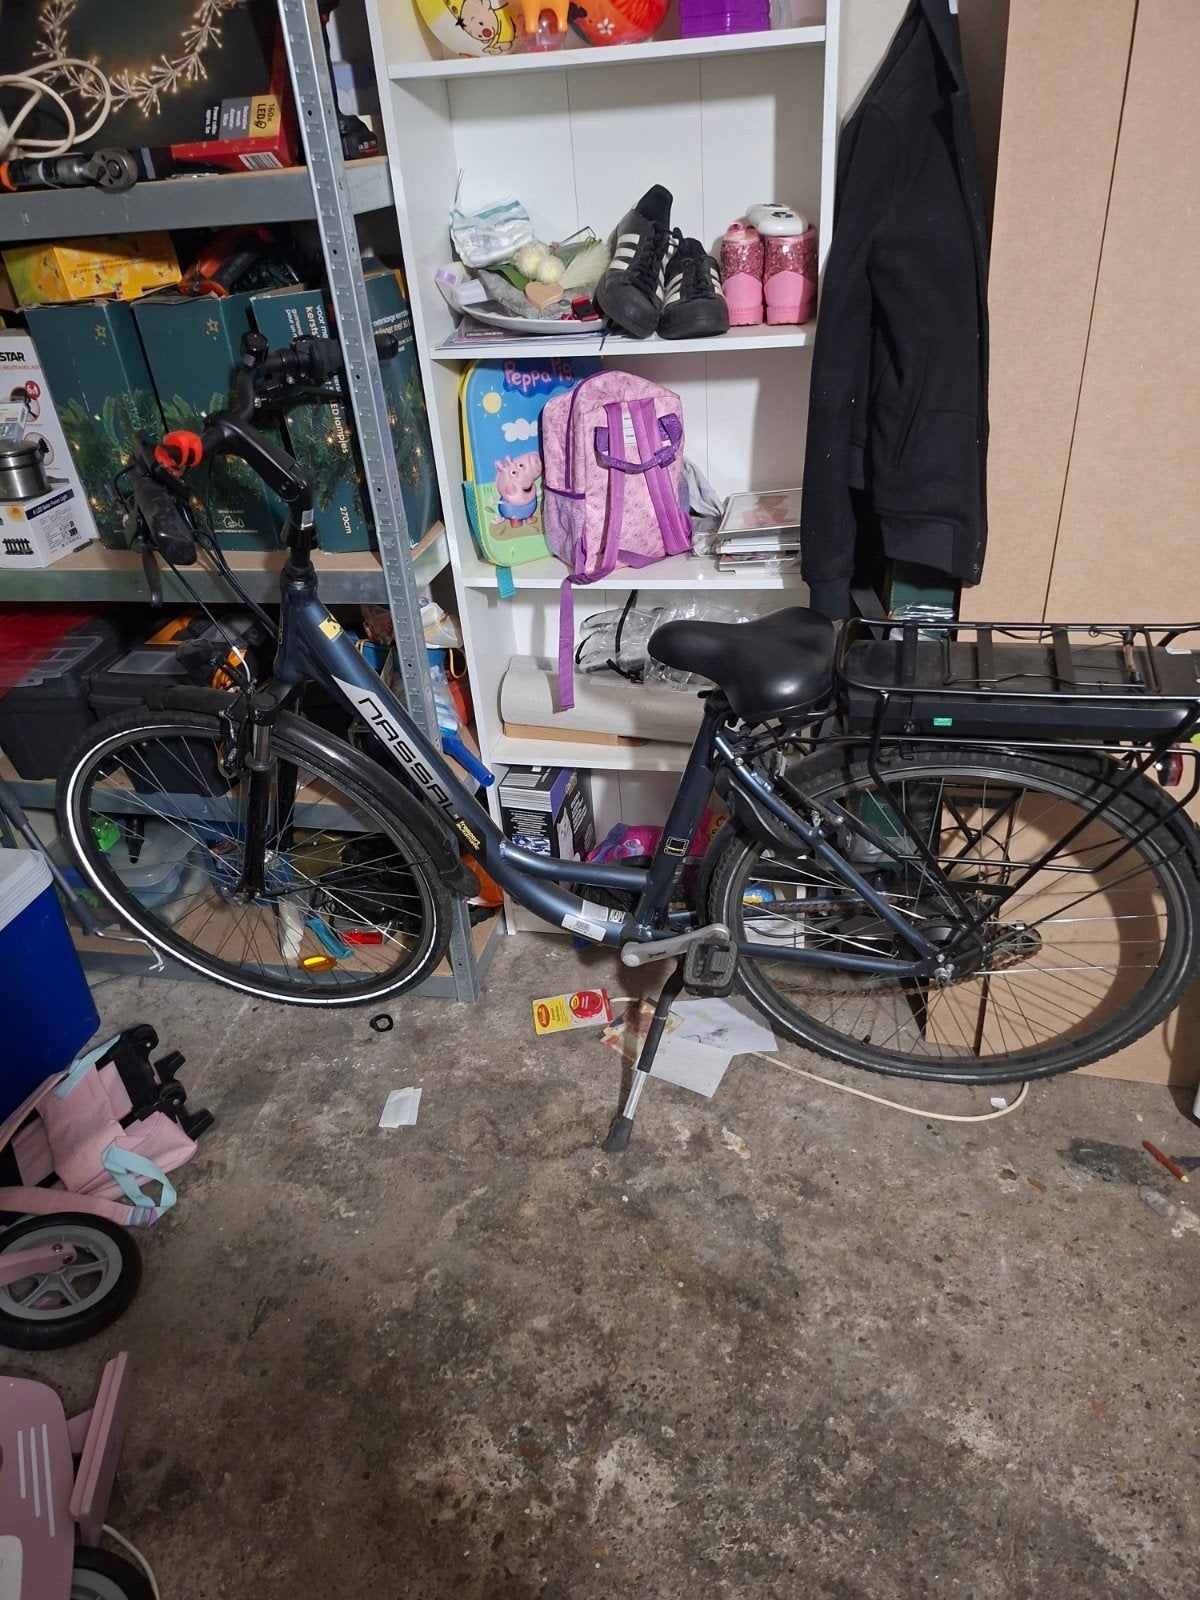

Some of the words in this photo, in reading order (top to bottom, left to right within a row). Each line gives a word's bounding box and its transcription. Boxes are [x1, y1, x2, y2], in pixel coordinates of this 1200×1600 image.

[256, 103, 267, 120] LED
[267, 103, 275, 122] 160x
[291, 308, 303, 337] guirland
[305, 306, 320, 338] kersts
[316, 305, 325, 325] voor
[0, 351, 26, 362] STAR
[551, 357, 572, 382] Pig
[504, 361, 552, 393] Peppa
[334, 416, 349, 454] lampjes
[339, 506, 352, 534] 270cm
